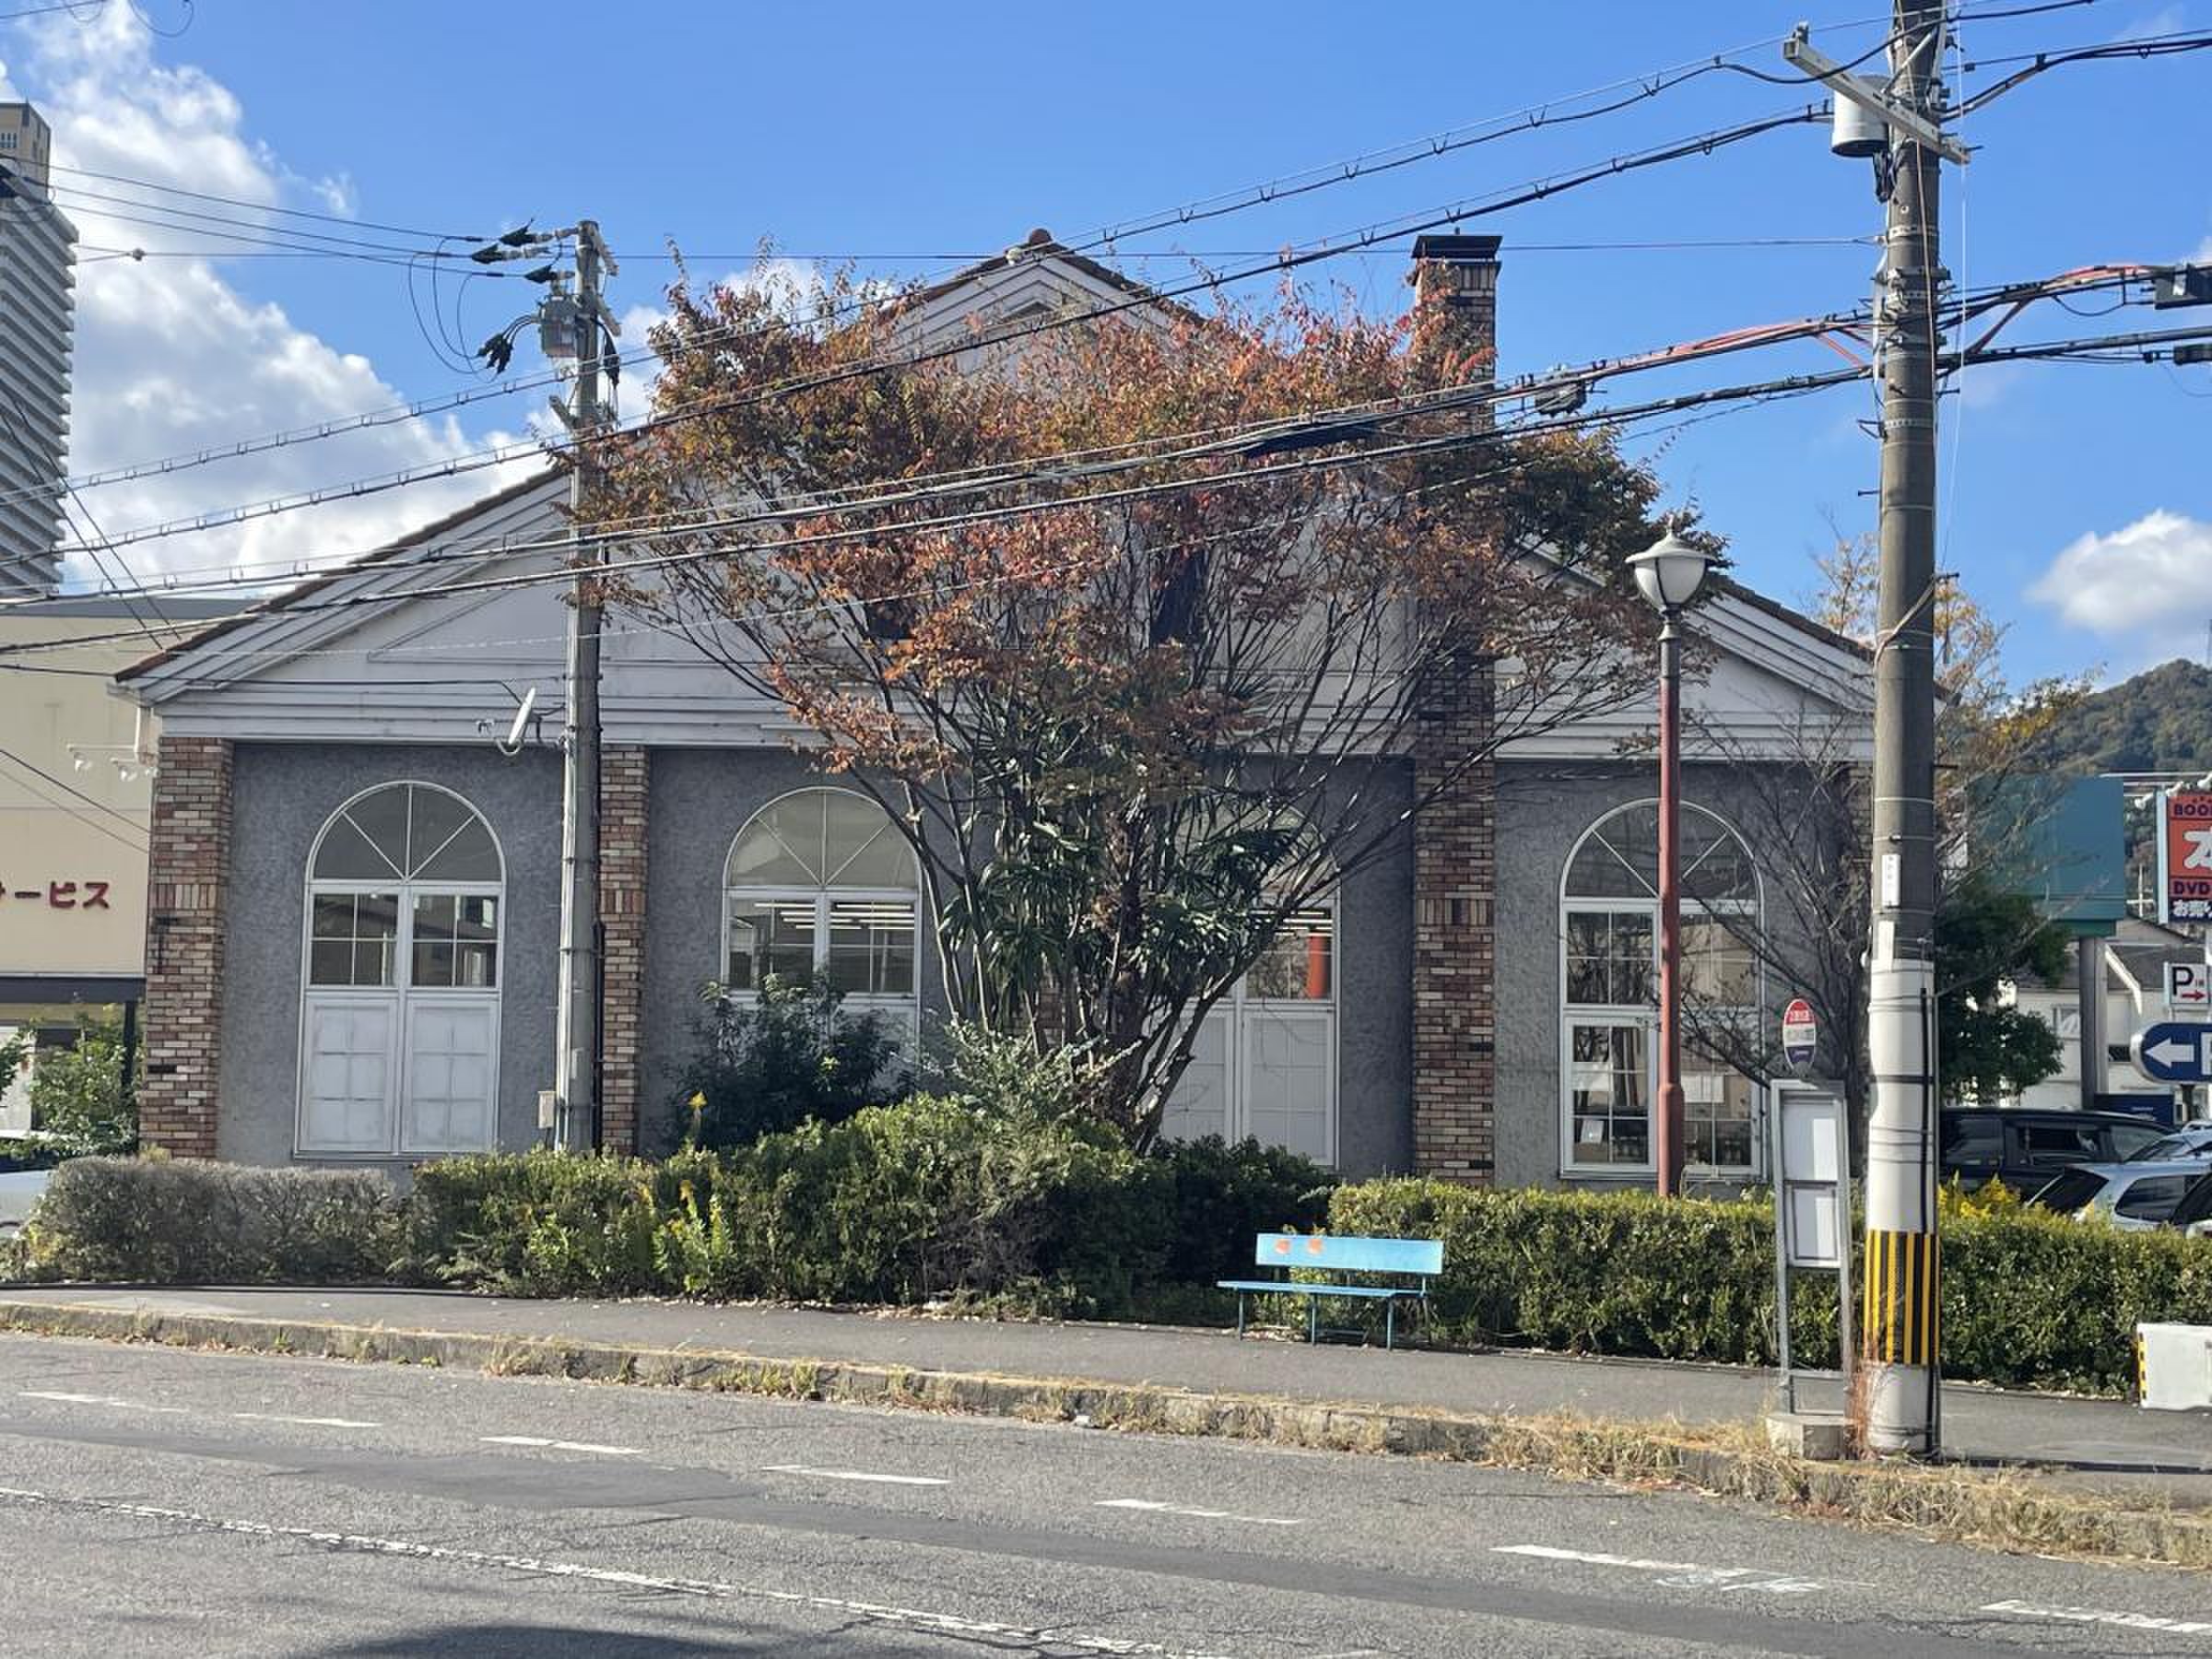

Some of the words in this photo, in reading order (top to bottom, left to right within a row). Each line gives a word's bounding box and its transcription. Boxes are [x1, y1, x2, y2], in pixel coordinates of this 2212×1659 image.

[2173, 804, 2212, 817] BOO
[0, 880, 110, 910] ービス
[2173, 881, 2210, 895] DVD
[2171, 966, 2194, 996] P
